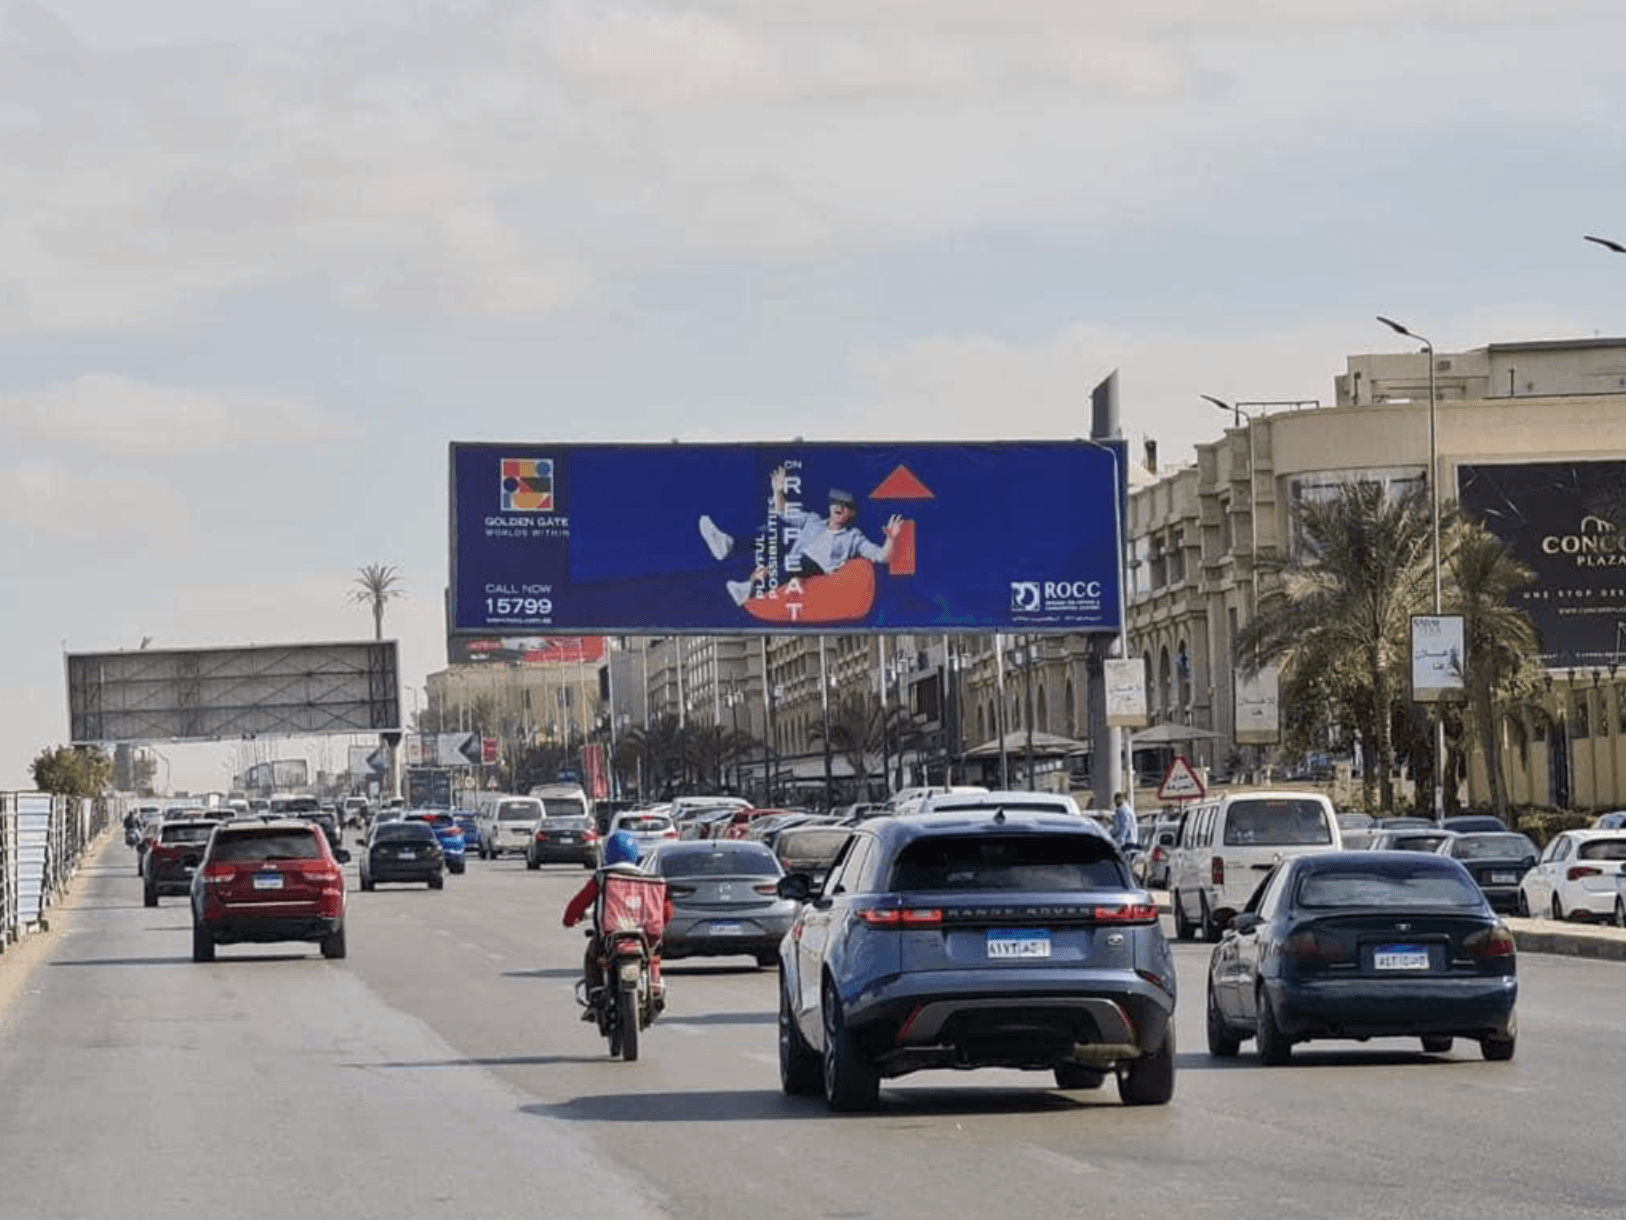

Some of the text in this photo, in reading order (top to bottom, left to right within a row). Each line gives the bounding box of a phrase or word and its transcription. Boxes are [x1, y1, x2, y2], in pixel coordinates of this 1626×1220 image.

[484, 516, 569, 527] GOLDEN GATE
[784, 476, 804, 621] REPEAT
[755, 533, 765, 598] PLAYFUL
[1577, 555, 1626, 567] PLAZA
[485, 584, 553, 595] CALL NOW
[1044, 581, 1101, 598] ROCC
[486, 597, 553, 615] 15799
[947, 906, 1091, 917] RANGE ROVER
